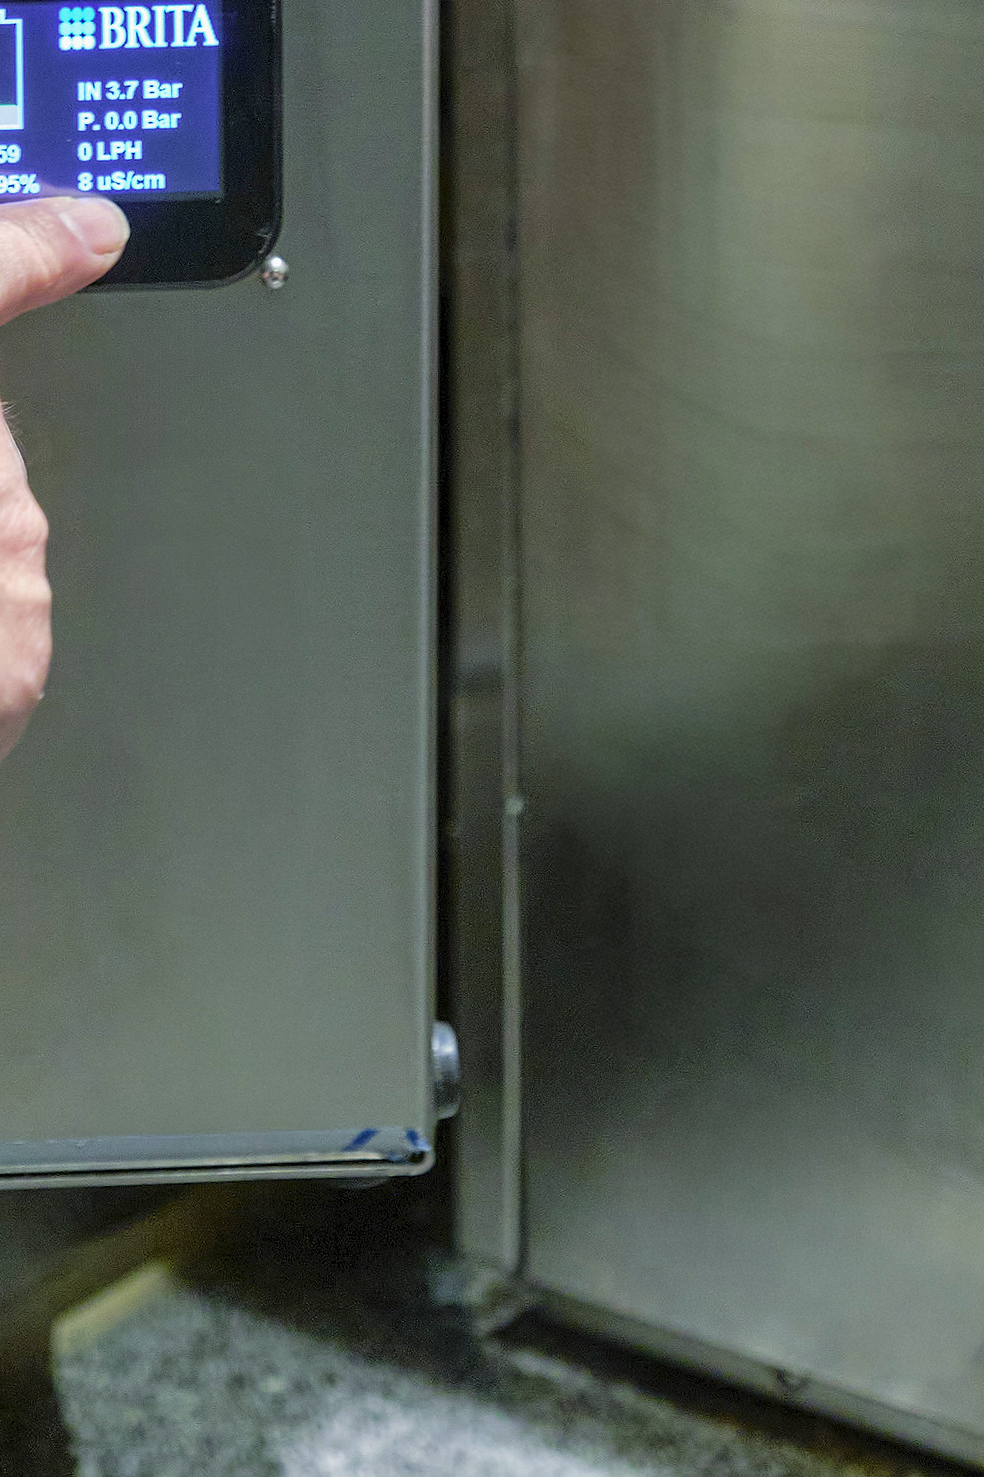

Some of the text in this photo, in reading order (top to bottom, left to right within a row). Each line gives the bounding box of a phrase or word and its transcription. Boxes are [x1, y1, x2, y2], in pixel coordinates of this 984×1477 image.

[98, 4, 220, 49] BRITA
[77, 79, 183, 101] IN 3.7 Bar
[77, 110, 182, 131] P. 0.0 Bar
[77, 140, 143, 162] 0 LPH
[77, 171, 166, 192] 8 uS/cm
